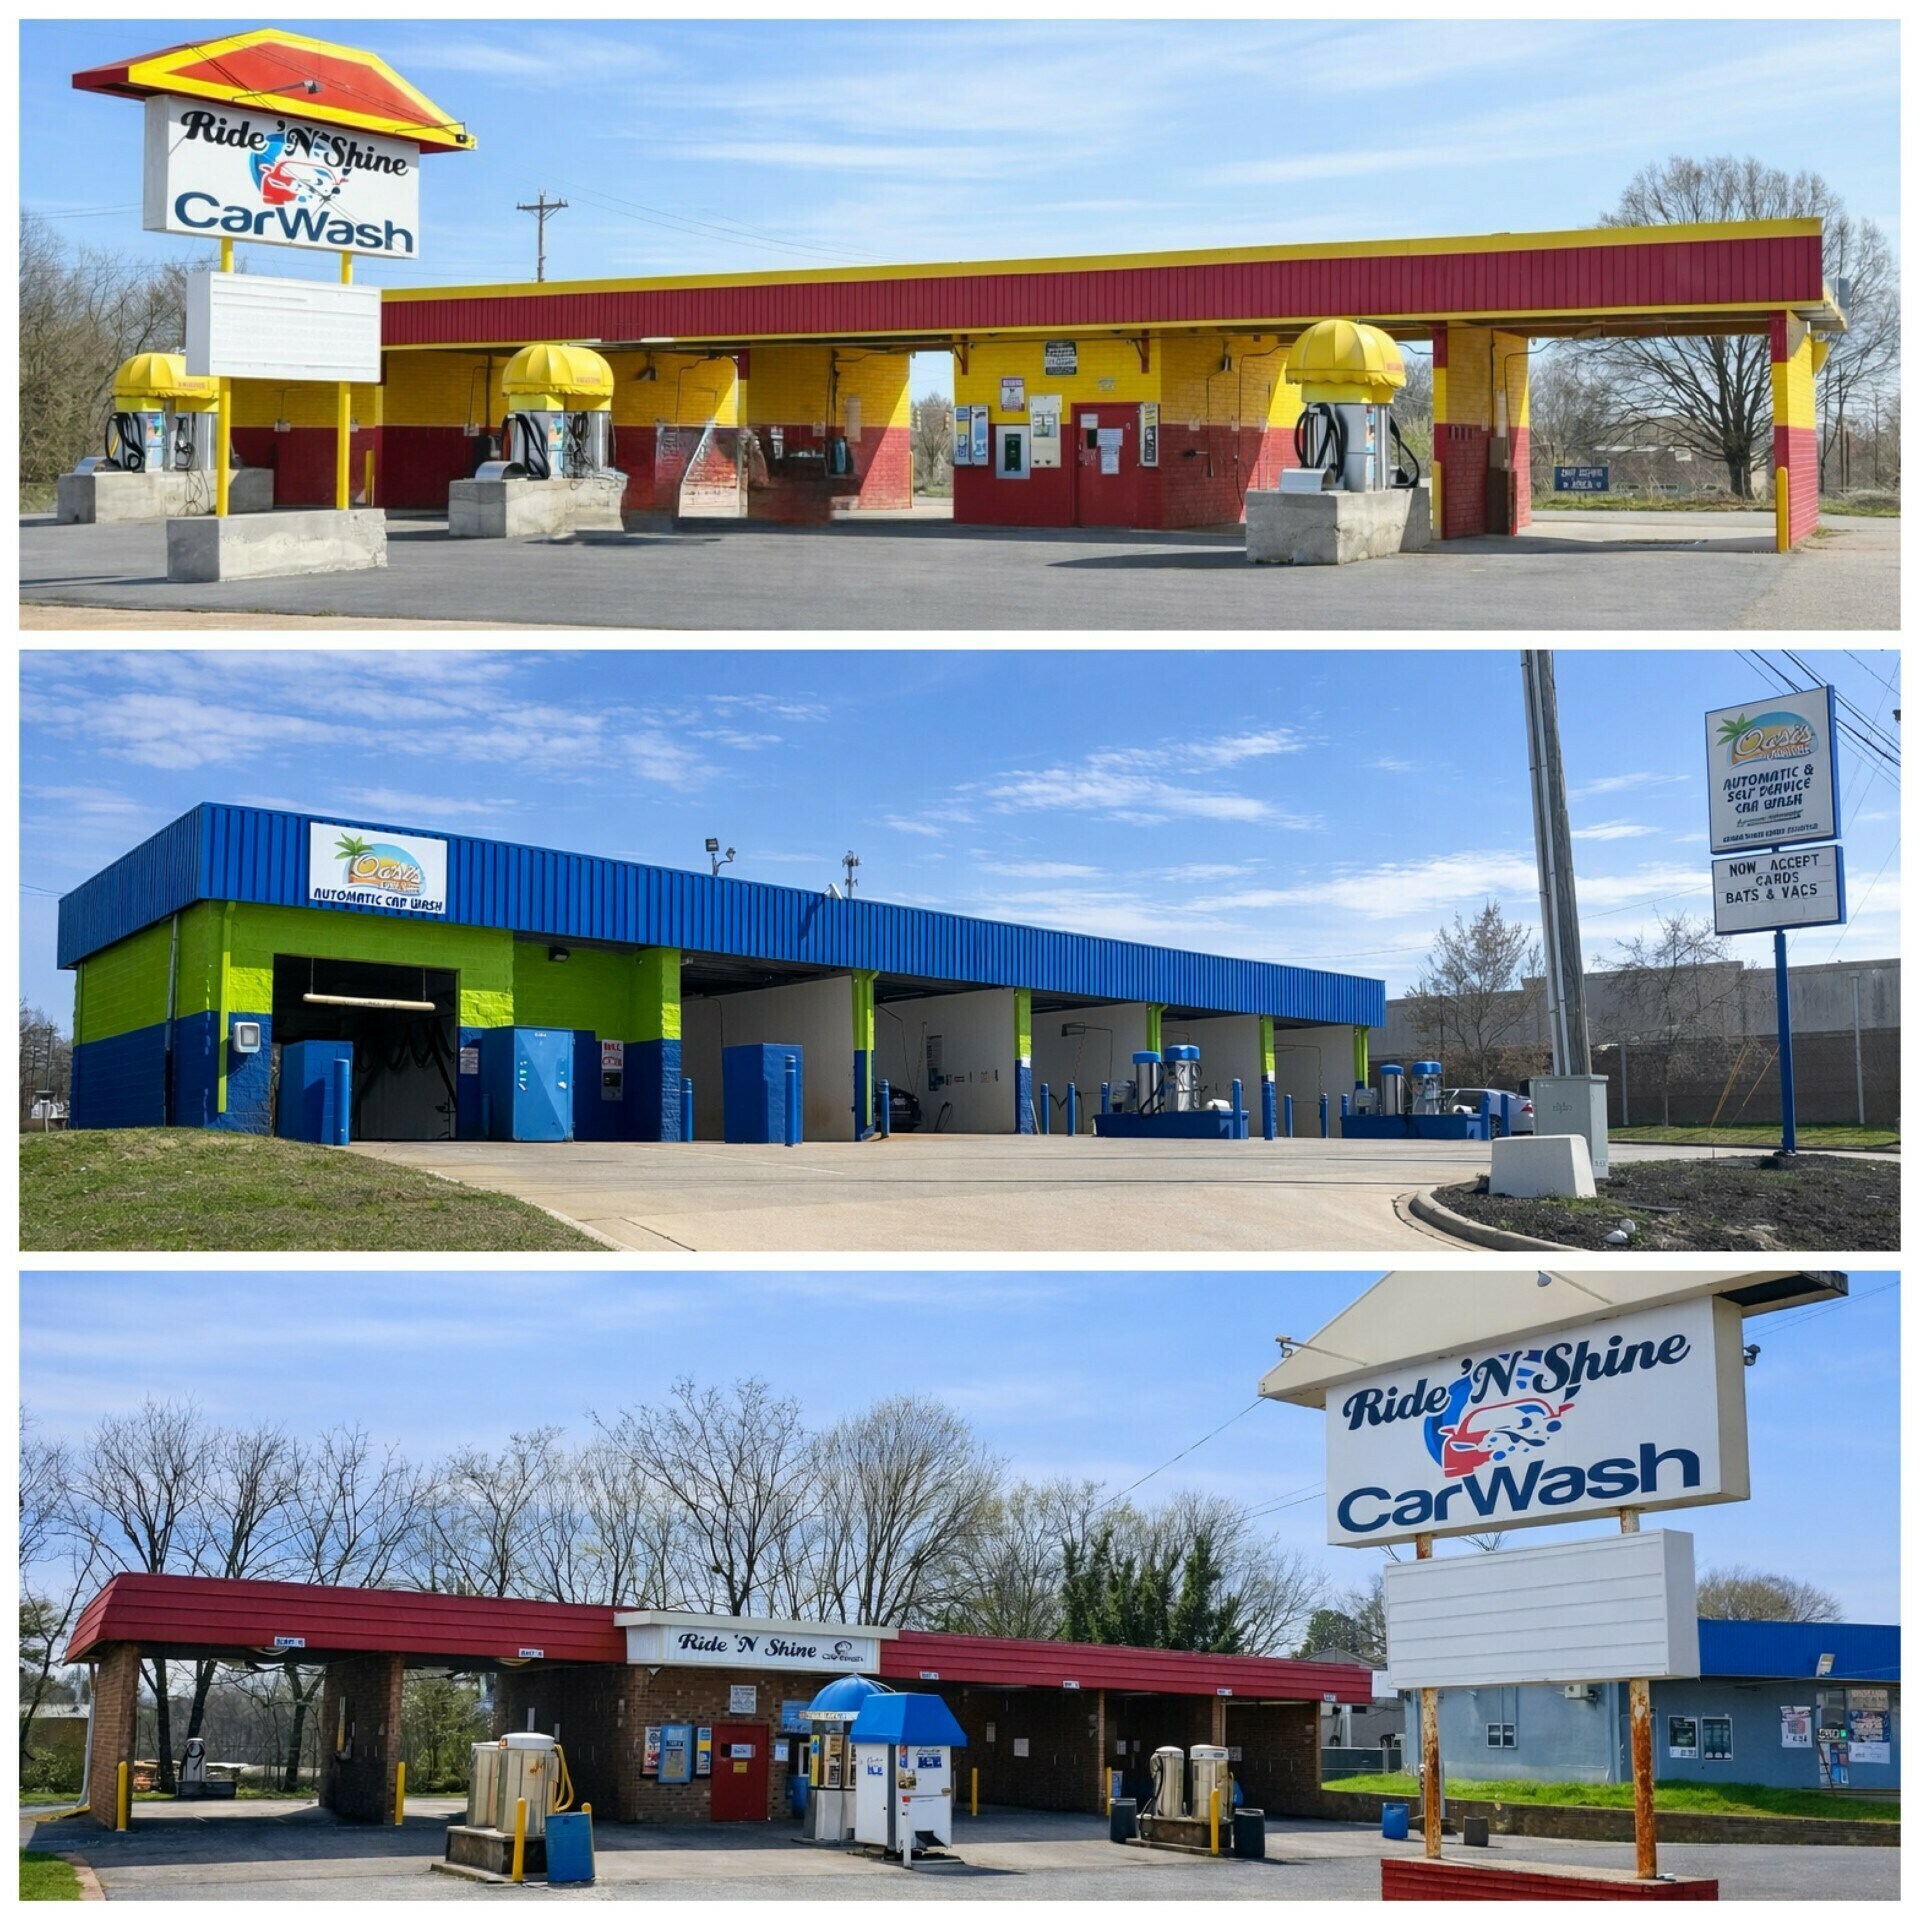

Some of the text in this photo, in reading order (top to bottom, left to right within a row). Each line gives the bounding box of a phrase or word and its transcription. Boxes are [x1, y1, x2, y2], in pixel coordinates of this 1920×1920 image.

[181, 110, 269, 152] Ride
[323, 136, 409, 178] Shine
[1735, 723, 1813, 757] Oasis
[1723, 764, 1815, 791] AUTOMATIC &
[1729, 854, 1819, 877] NOW ACCEPT
[1756, 871, 1799, 886] CARDS
[314, 888, 381, 906] AUTOMATIC
[1766, 889, 1775, 900] &
[1782, 883, 1817, 899] VACS
[1342, 1378, 1451, 1431] Ride
[1532, 1333, 1691, 1396] Shine
[678, 1633, 728, 1653] Ride
[765, 1638, 817, 1658] Shine
